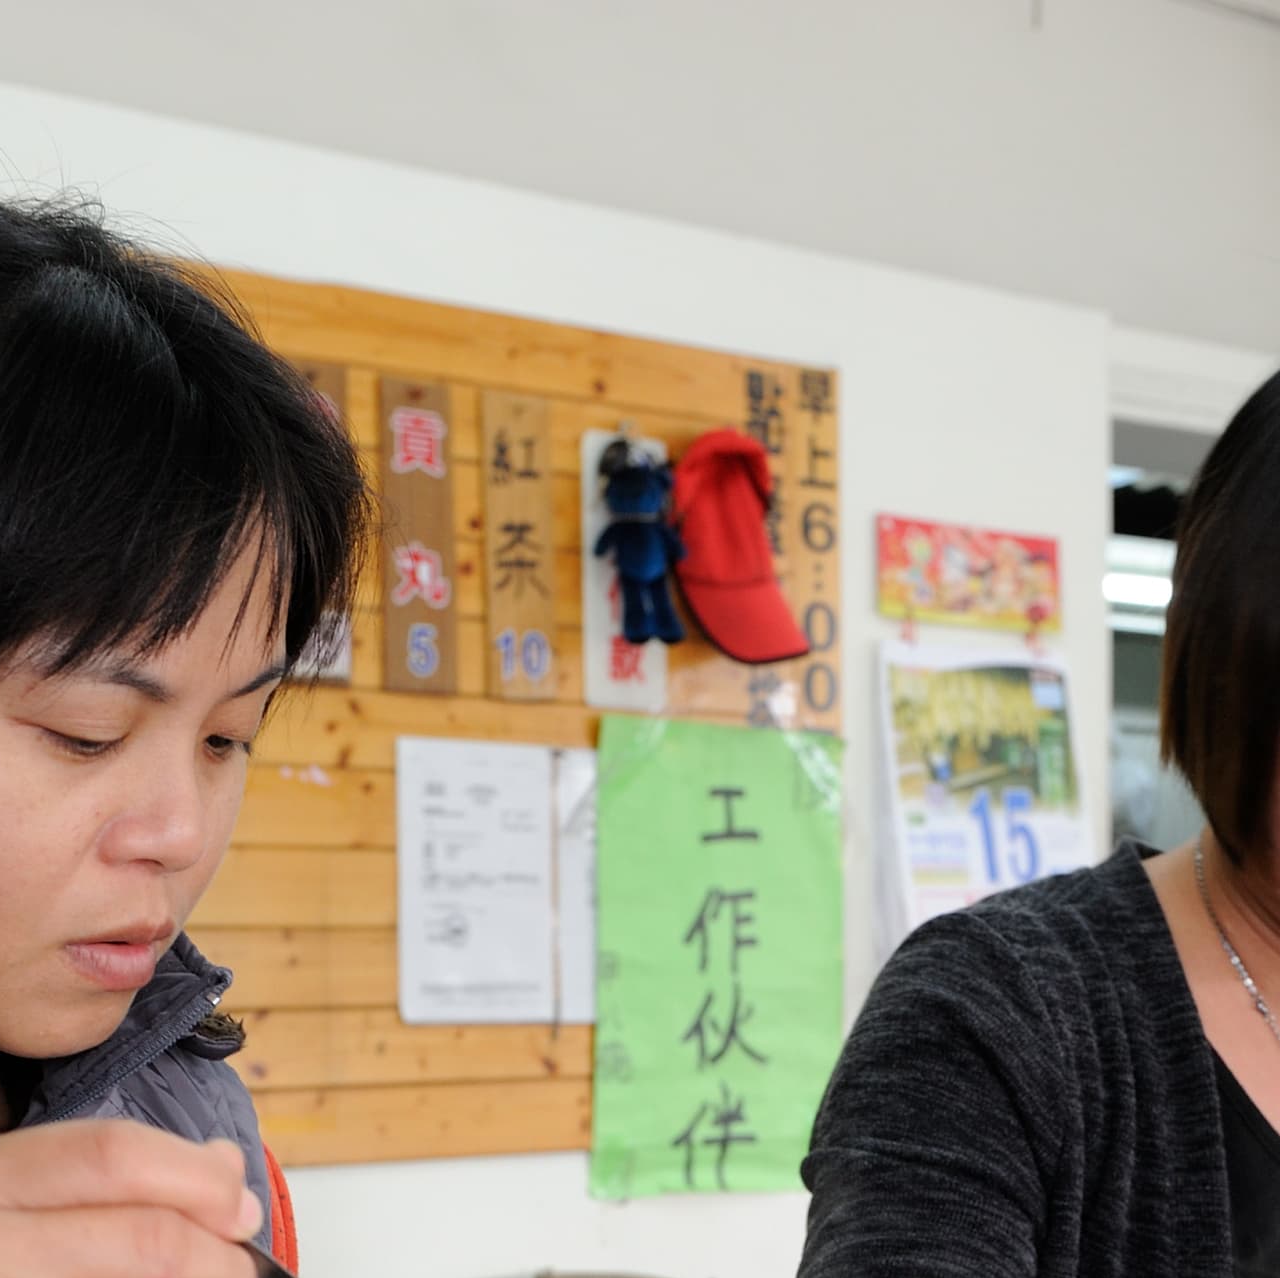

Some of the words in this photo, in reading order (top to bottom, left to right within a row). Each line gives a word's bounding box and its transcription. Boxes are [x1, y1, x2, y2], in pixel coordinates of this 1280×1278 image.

[390, 408, 451, 610] 貢丸
[799, 369, 839, 735] 早上6:00
[406, 622, 439, 678] 5
[495, 629, 551, 681] 10
[969, 786, 1039, 884] 15
[672, 787, 768, 1191] 工作伙伴
